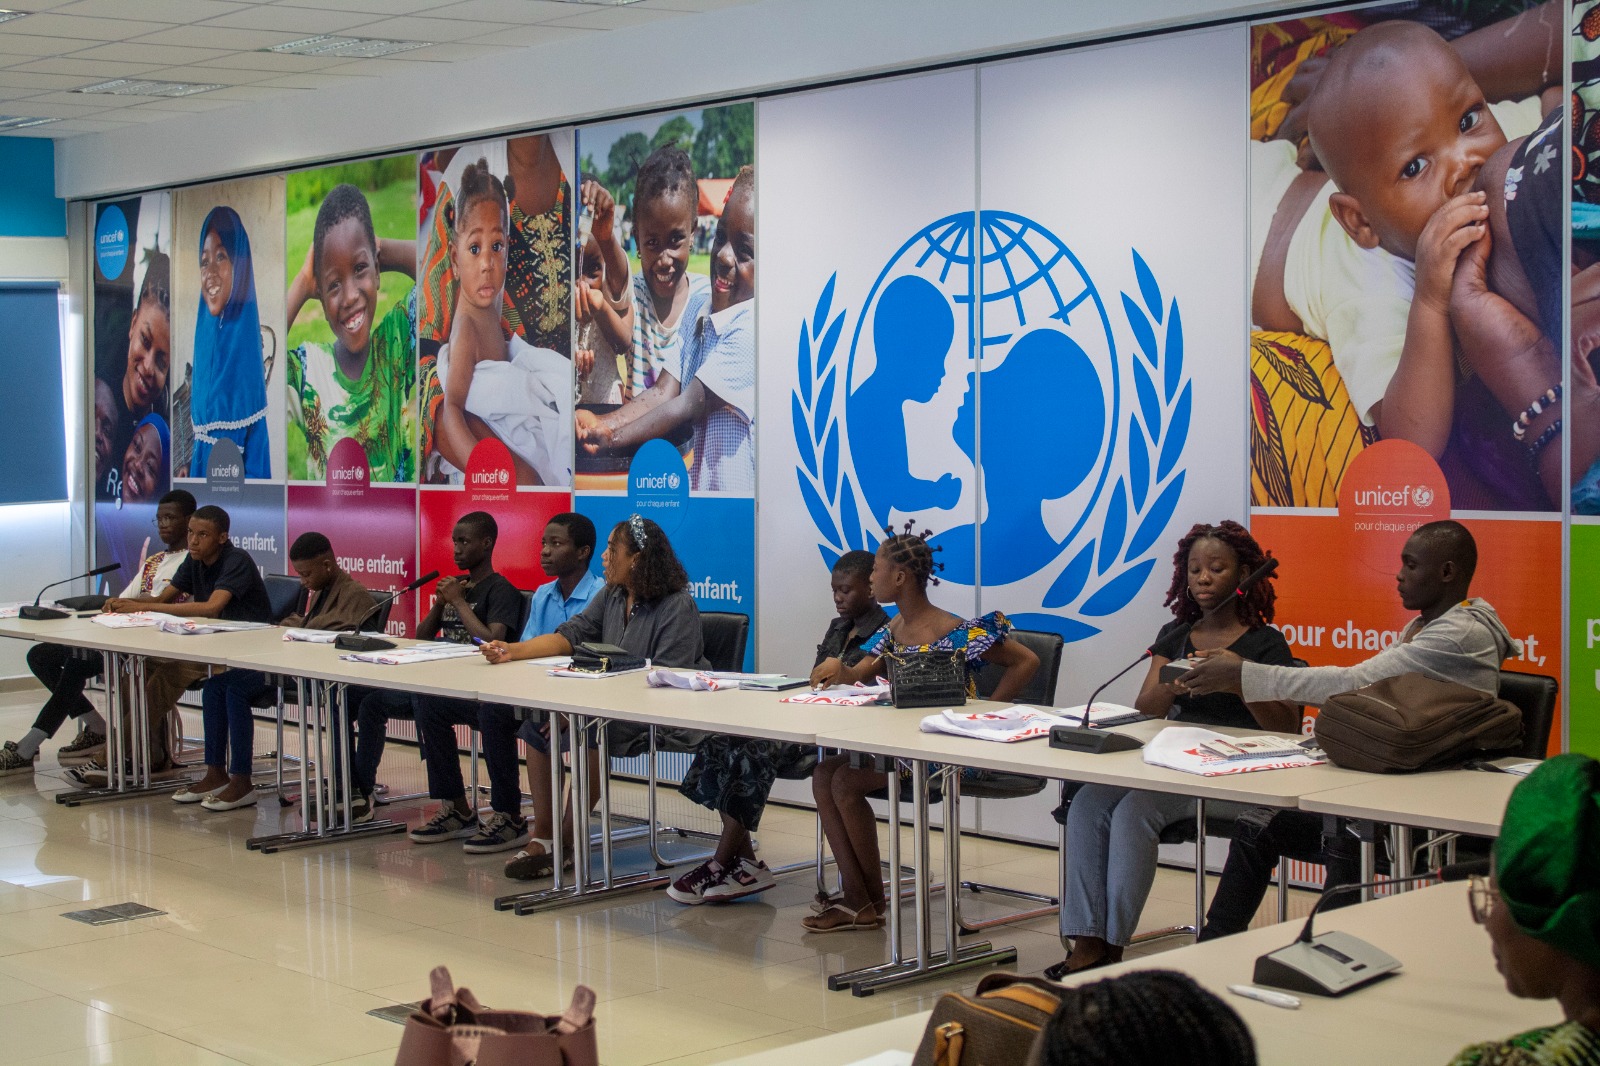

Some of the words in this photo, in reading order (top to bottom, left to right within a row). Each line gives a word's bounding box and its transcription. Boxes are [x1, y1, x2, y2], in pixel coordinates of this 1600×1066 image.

[101, 230, 117, 243] unicef
[211, 464, 231, 477] unicef
[332, 466, 355, 480] unicef
[472, 469, 498, 484] unicef
[636, 472, 667, 489] unicef
[1354, 485, 1410, 506] unicef
[1354, 522, 1374, 532] pour
[1374, 521, 1406, 533] chaque
[241, 532, 278, 554] enfant,
[366, 554, 408, 578] enfant,
[1266, 622, 1326, 647] our
